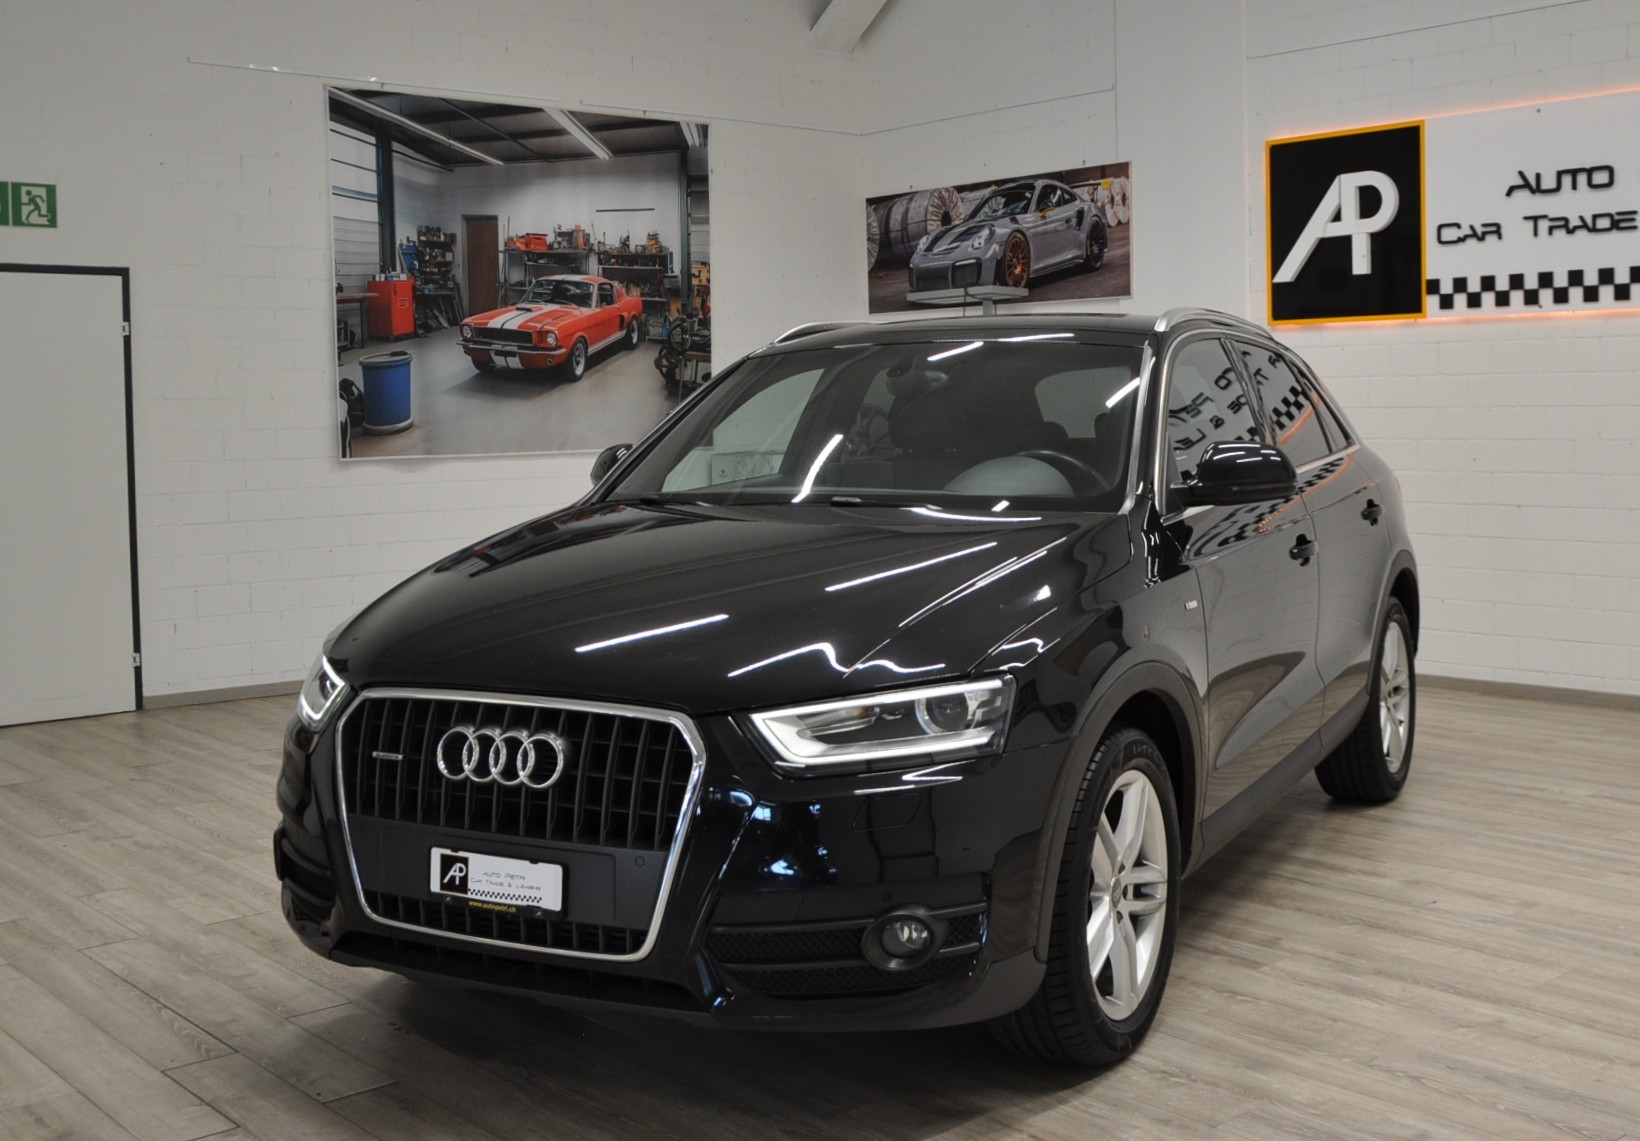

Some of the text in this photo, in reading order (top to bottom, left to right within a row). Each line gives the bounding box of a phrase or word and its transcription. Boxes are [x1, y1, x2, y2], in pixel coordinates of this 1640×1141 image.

[1505, 164, 1615, 197] AUTO
[1437, 210, 1639, 245] CAR TRADE
